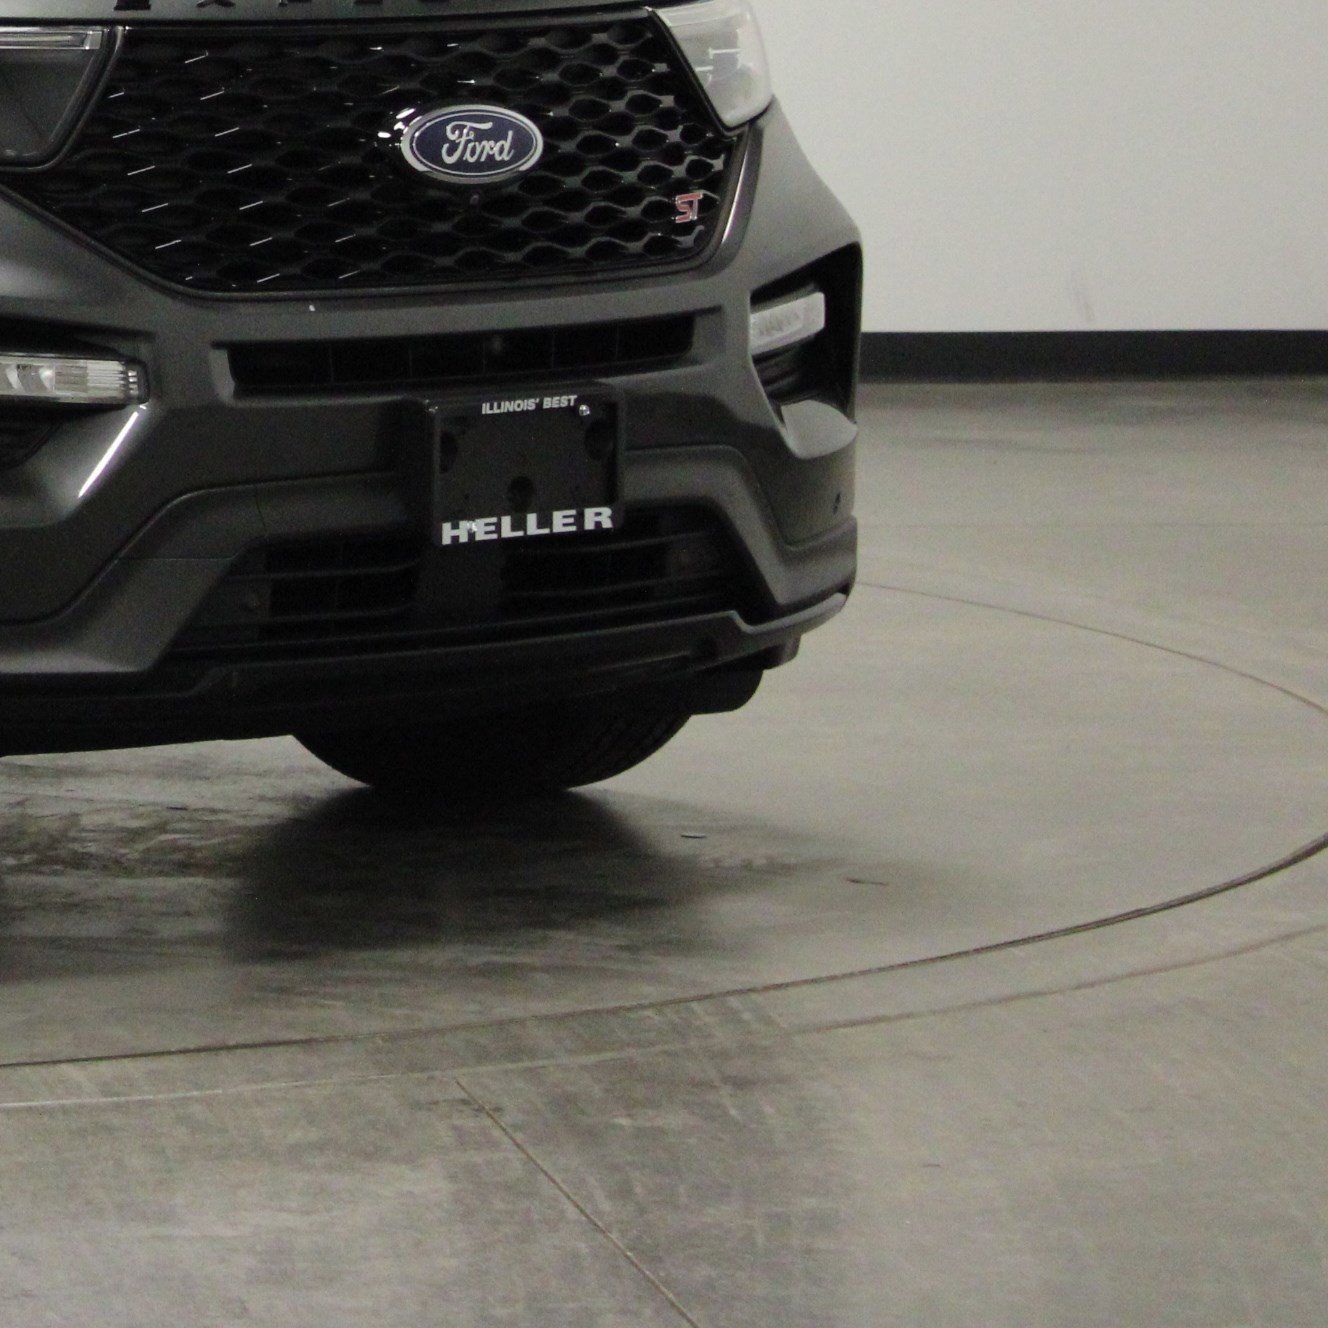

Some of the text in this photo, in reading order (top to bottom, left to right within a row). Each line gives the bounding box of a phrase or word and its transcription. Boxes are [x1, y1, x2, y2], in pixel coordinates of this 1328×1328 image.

[442, 120, 515, 164] Ford
[675, 192, 703, 223] ST
[543, 394, 578, 409] BEST
[442, 506, 613, 545] HELLER
